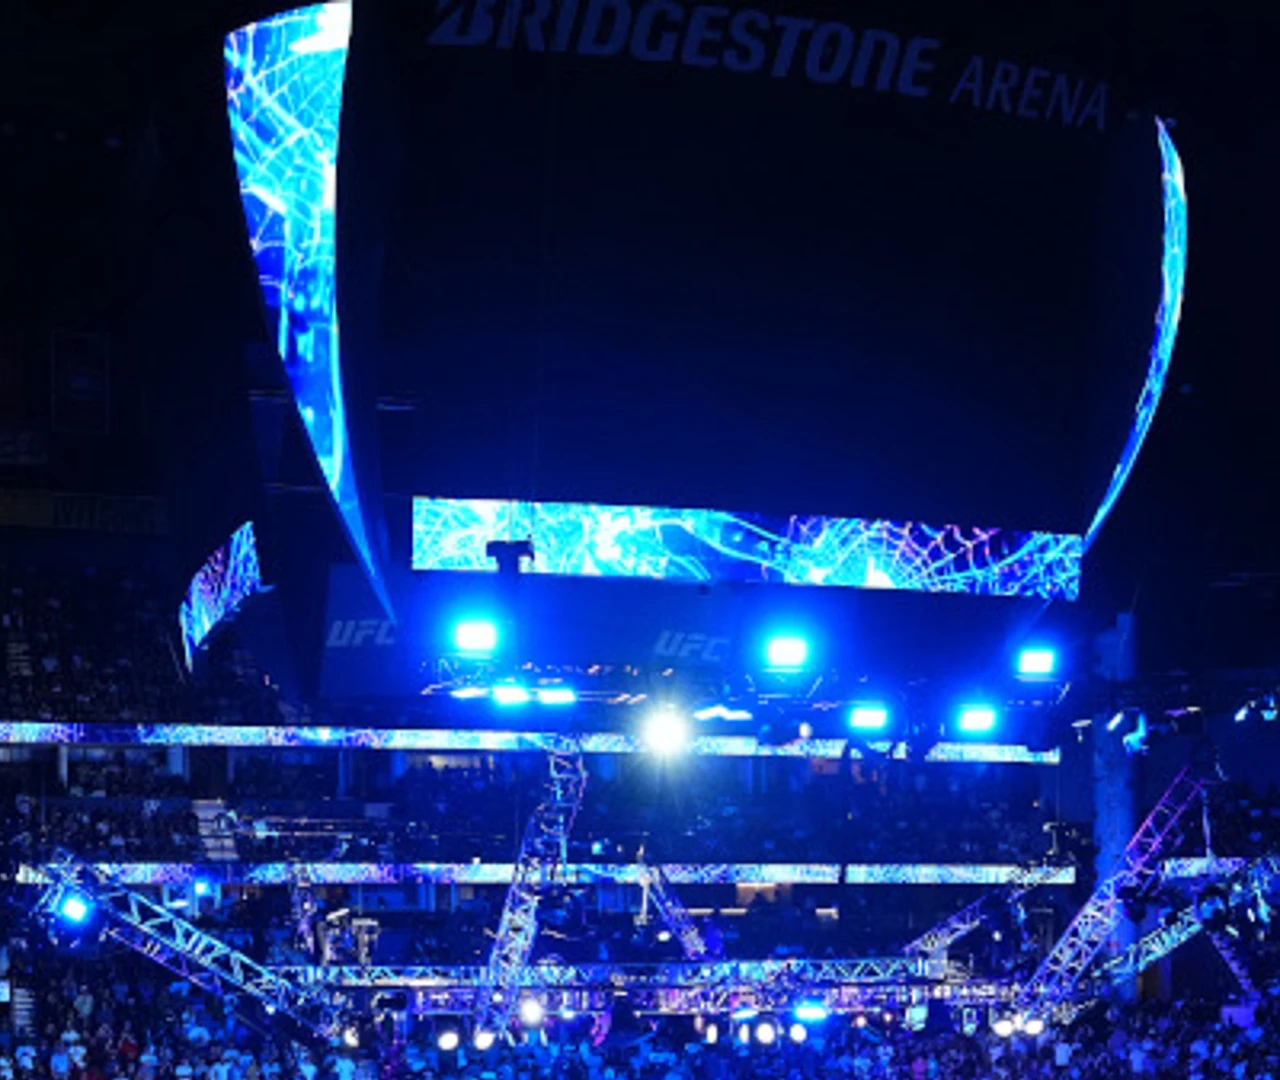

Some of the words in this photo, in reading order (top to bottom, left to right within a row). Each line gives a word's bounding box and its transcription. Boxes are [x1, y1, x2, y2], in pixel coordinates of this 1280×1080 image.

[424, 0, 941, 97] BRIDGESTONE
[951, 53, 1110, 130] ARENA
[325, 619, 397, 647] UFC
[652, 628, 732, 662] UFC
